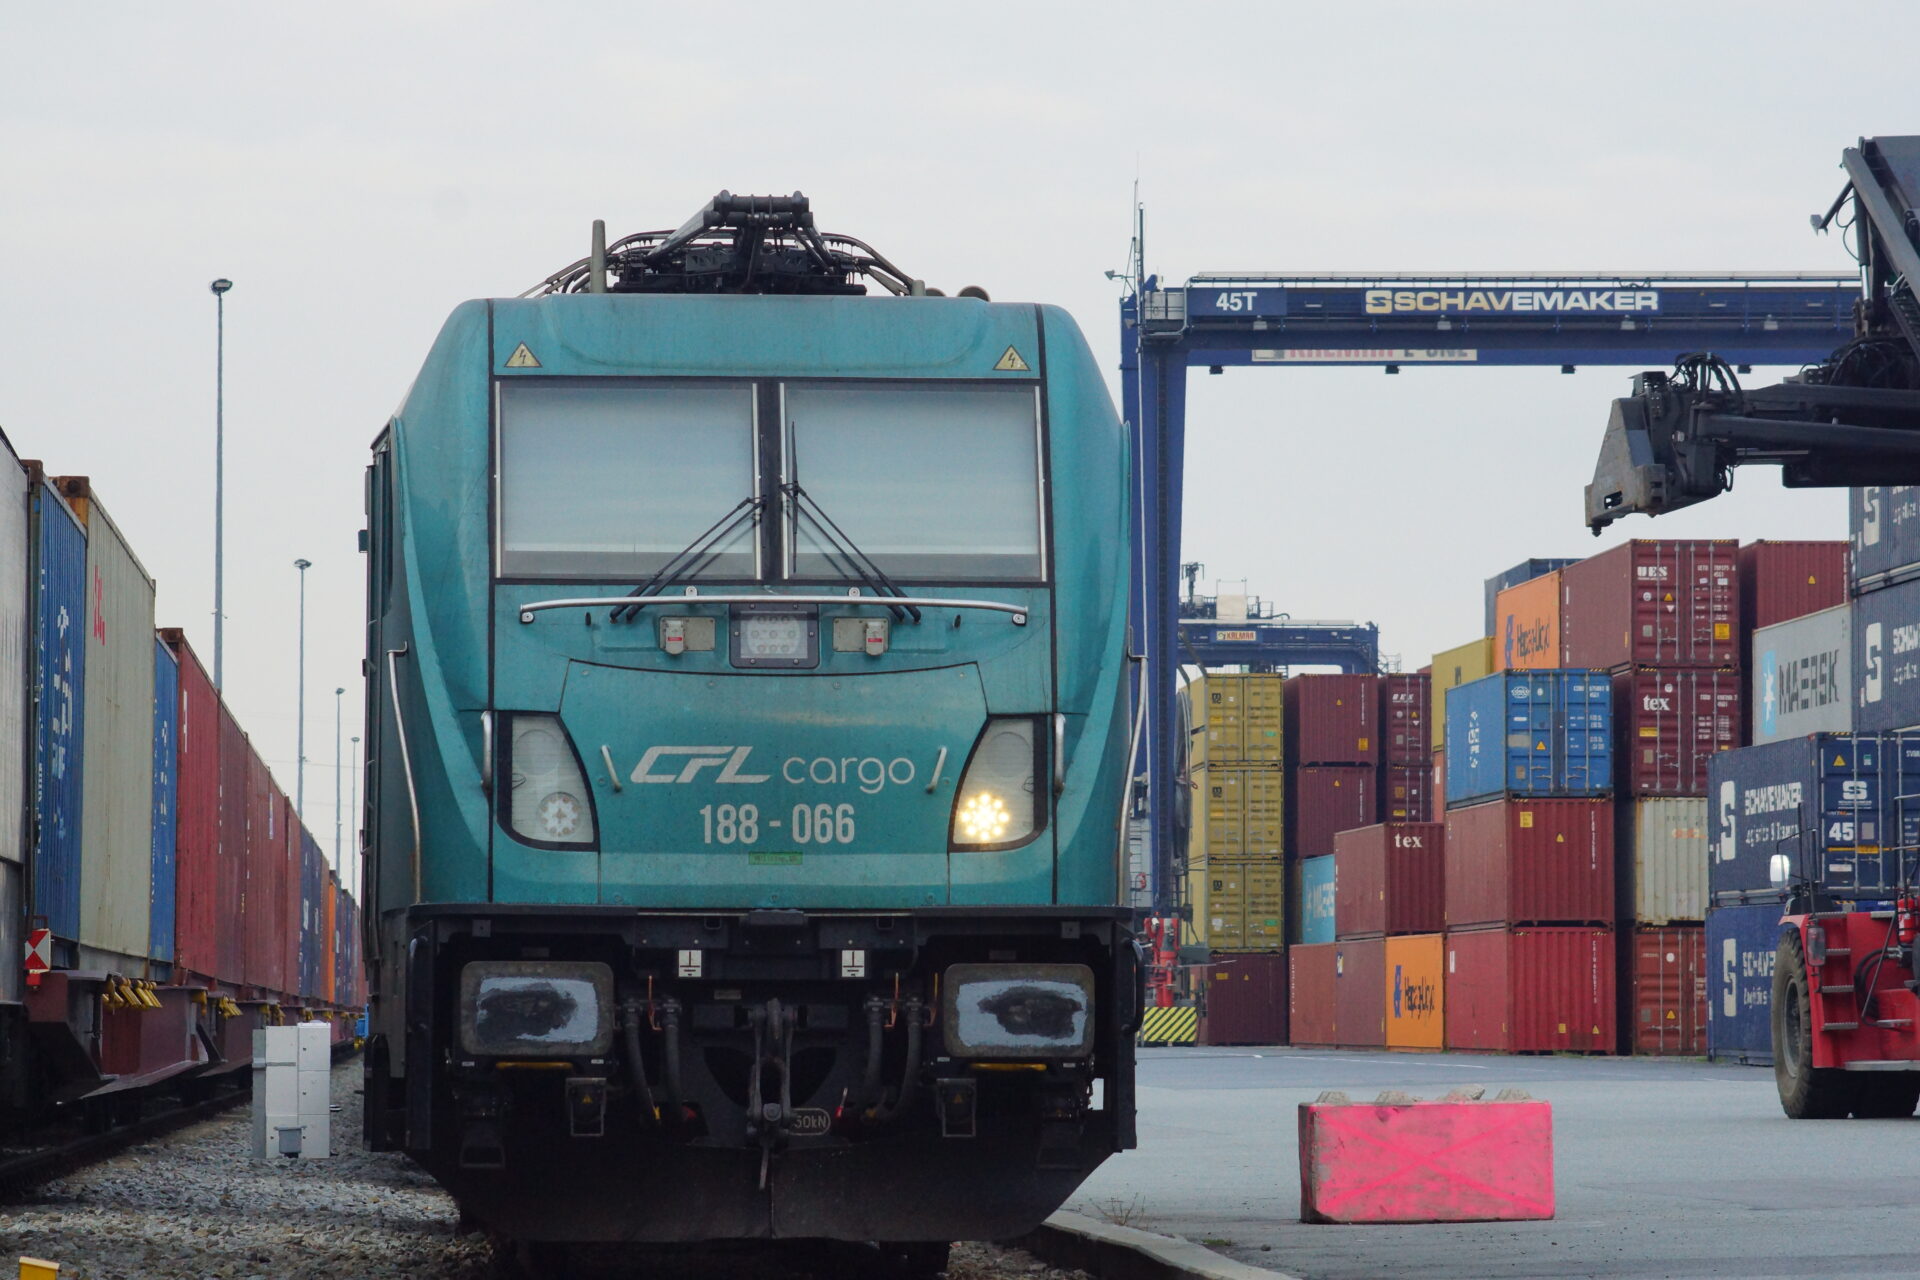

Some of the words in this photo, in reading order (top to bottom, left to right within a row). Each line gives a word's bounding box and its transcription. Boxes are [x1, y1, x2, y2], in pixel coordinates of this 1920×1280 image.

[1215, 291, 1258, 311] 45T
[1394, 291, 1658, 311] SCHAVEMAKER
[1778, 649, 1840, 716] MAERSK
[1642, 694, 1671, 711] tex
[630, 745, 772, 783] CFL
[782, 756, 916, 794] cargo
[699, 803, 759, 844] 188
[791, 803, 855, 844] 066
[1828, 822, 1854, 841] 45
[1394, 833, 1423, 848] tex
